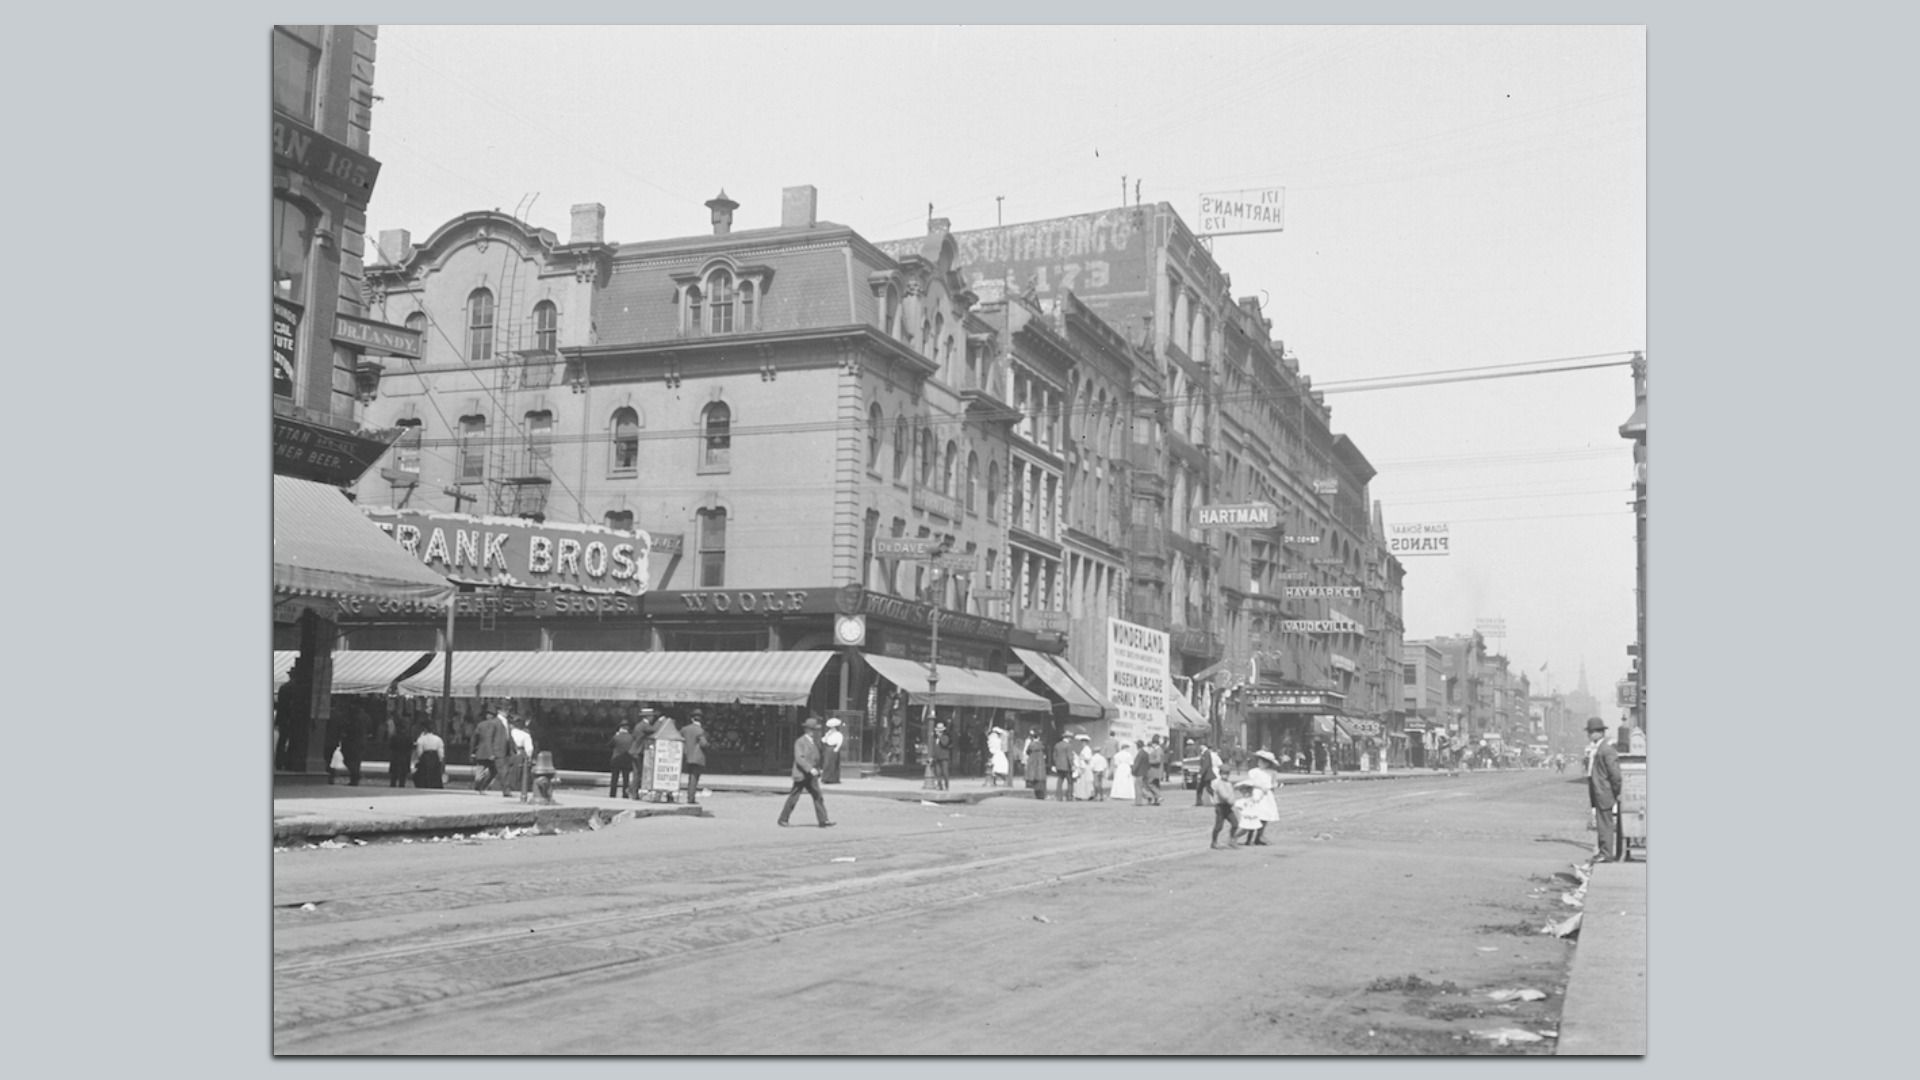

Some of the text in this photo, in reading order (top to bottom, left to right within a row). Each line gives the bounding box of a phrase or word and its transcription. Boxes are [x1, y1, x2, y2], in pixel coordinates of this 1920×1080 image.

[360, 324, 418, 353] TANDY.
[274, 424, 312, 444] TTAN
[274, 441, 304, 461] NER
[1200, 508, 1269, 524] HARTMAN
[680, 590, 808, 612] WOOLF
[1285, 587, 1361, 599] HAYMARKET
[554, 594, 635, 613] SHOES.
[1286, 621, 1356, 633] VAUDEVILLE
